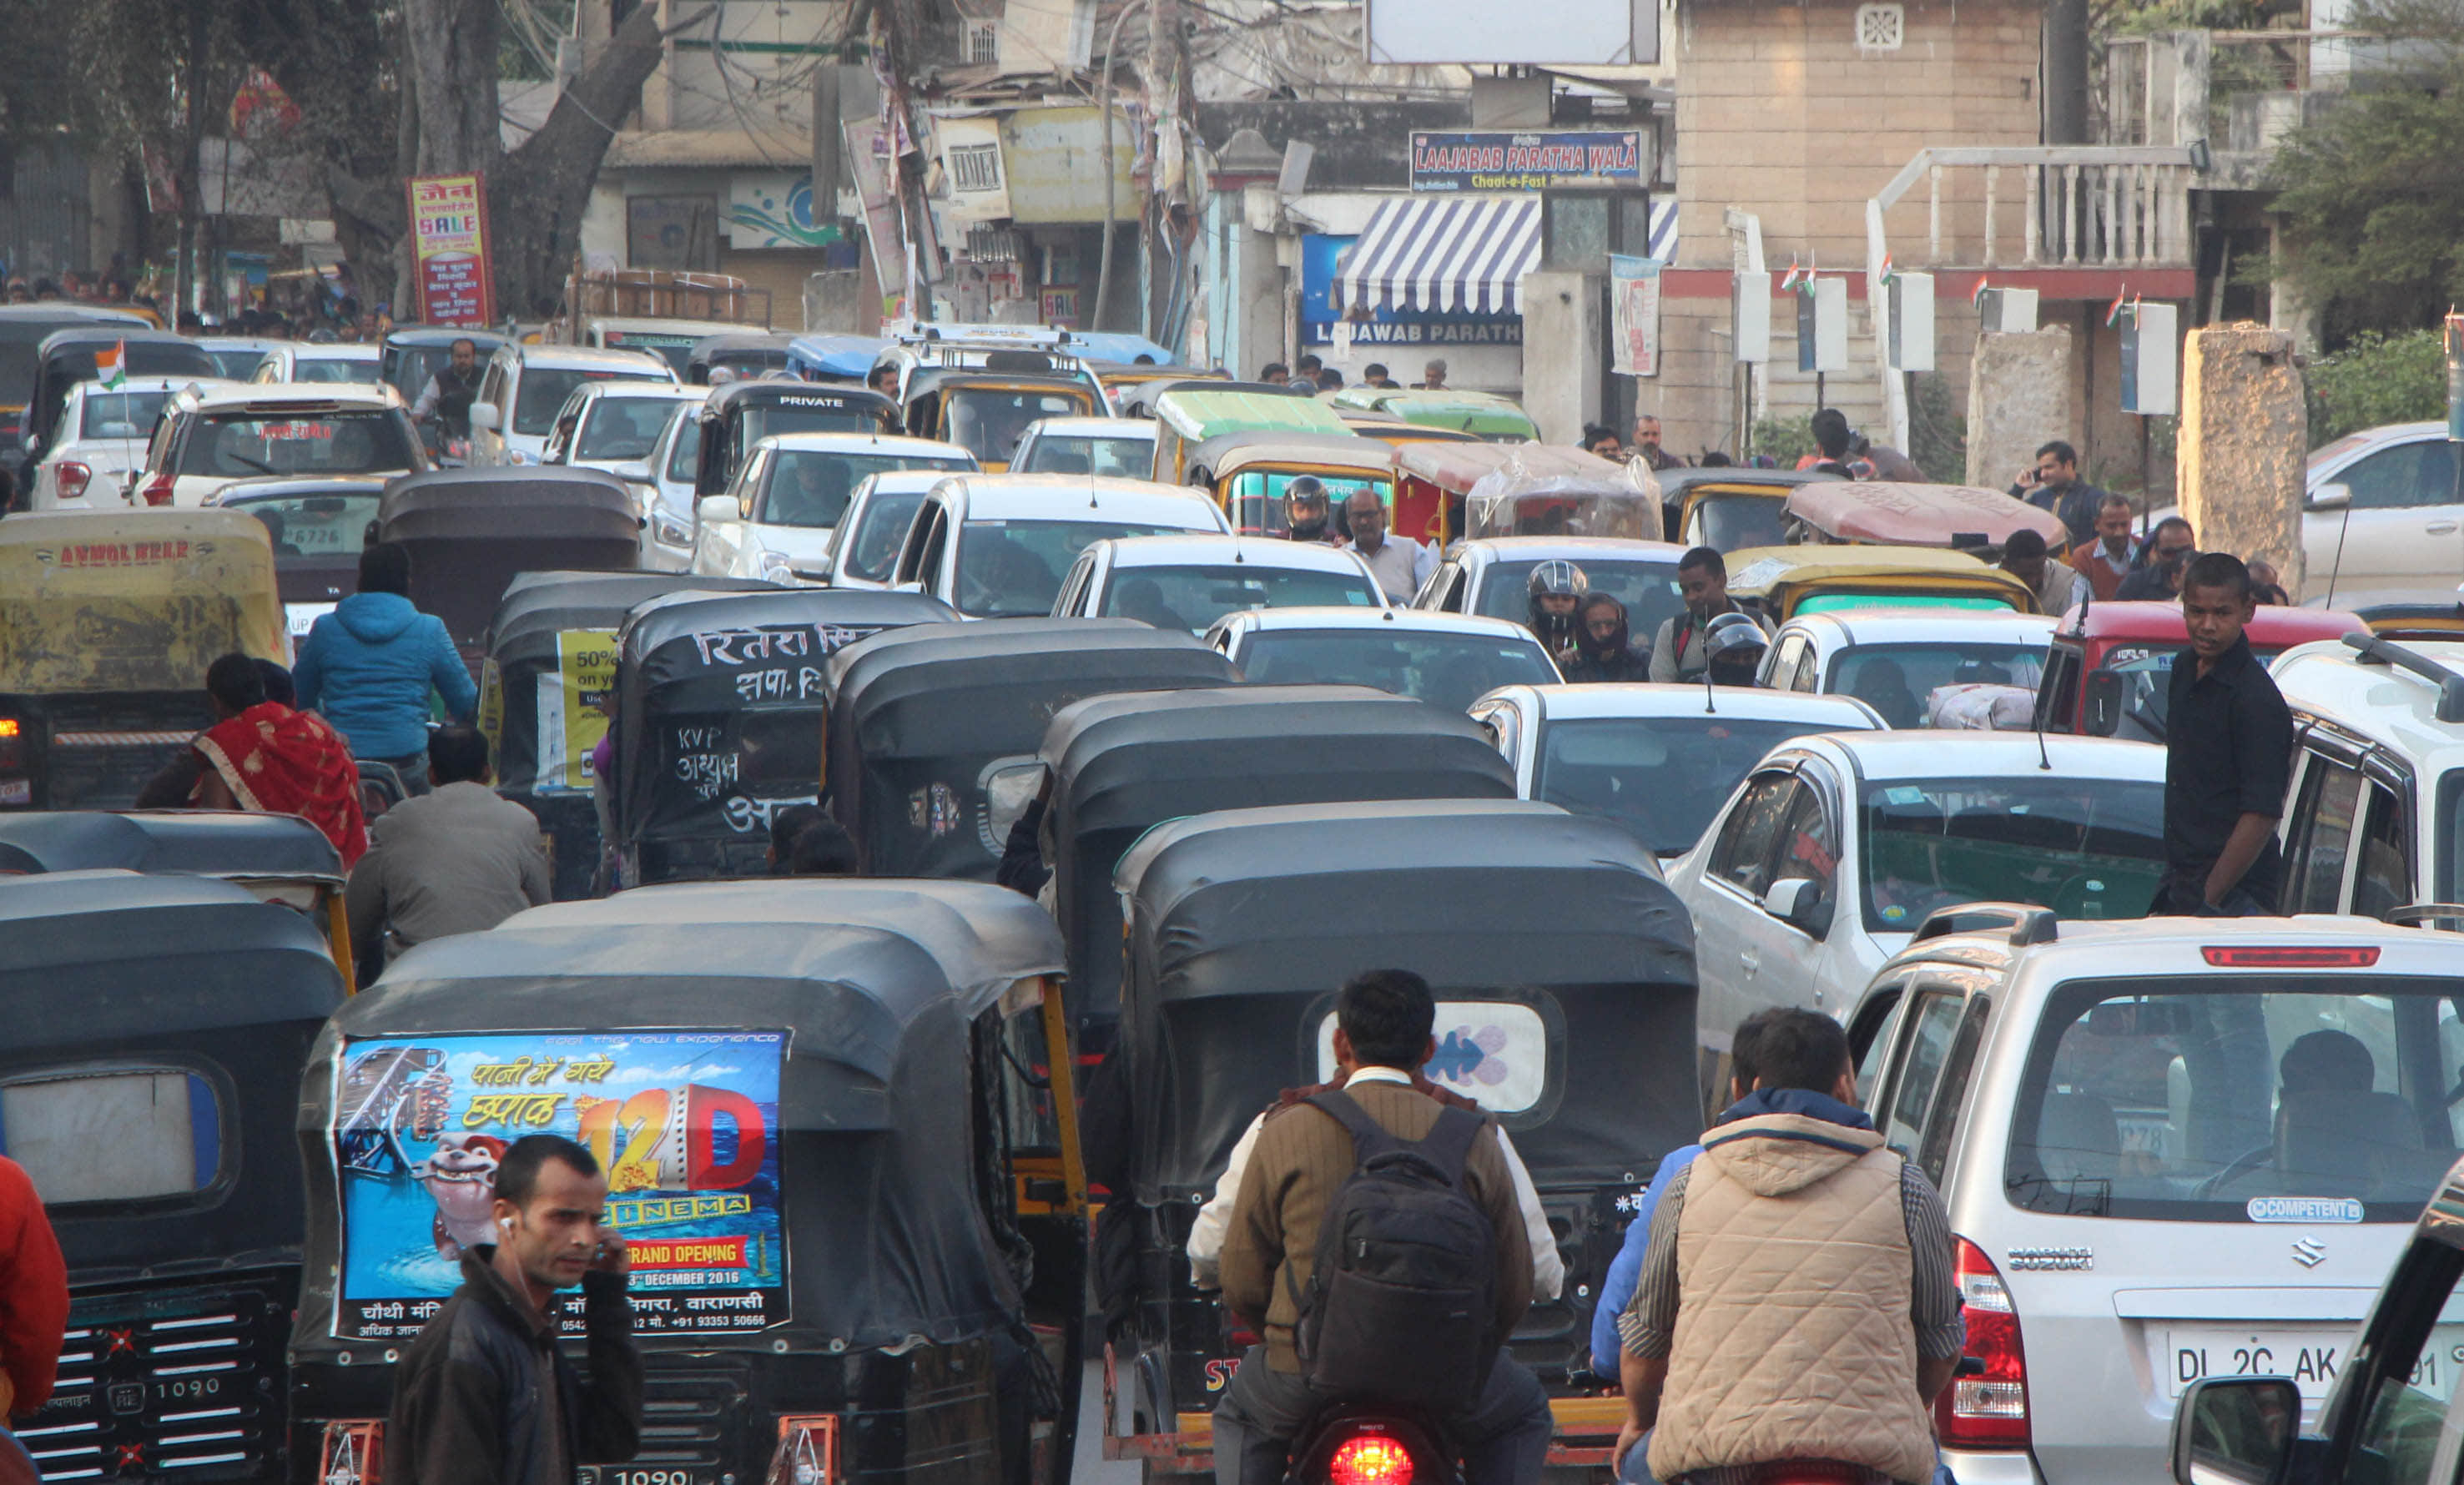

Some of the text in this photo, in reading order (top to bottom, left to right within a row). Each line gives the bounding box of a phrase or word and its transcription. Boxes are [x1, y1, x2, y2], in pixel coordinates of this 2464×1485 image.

[1415, 146, 1635, 172] LAAJABAB PARATHA WALA
[419, 215, 475, 234] SALE
[1429, 324, 1520, 342] PARATH
[780, 396, 843, 407] PRIVATE
[292, 619, 309, 631] UP
[577, 650, 618, 668] 50%
[577, 674, 597, 687] on
[472, 1054, 615, 1085] पानी में गये
[462, 1093, 568, 1127] छपाक
[576, 1083, 766, 1193] 12D
[2267, 1200, 2347, 1217] COMPETENT
[627, 1244, 737, 1265] RAND OPENING
[2008, 1247, 2093, 1257] MARUTI
[2008, 1257, 2094, 1271] SUZUKI
[645, 1272, 705, 1286] DECEMBER
[708, 1271, 740, 1285] 2016
[360, 1302, 404, 1320] चौथी
[685, 1291, 764, 1311] वाराणसी
[359, 1323, 394, 1336] अधिक
[562, 1320, 587, 1331] 0542
[649, 1315, 666, 1328] मो.
[672, 1317, 693, 1327] +91
[698, 1316, 729, 1327] 93353
[733, 1315, 766, 1326] 50666
[2295, 1347, 2336, 1382] AK
[1205, 1358, 1241, 1392] ST
[156, 1377, 220, 1399] 1090
